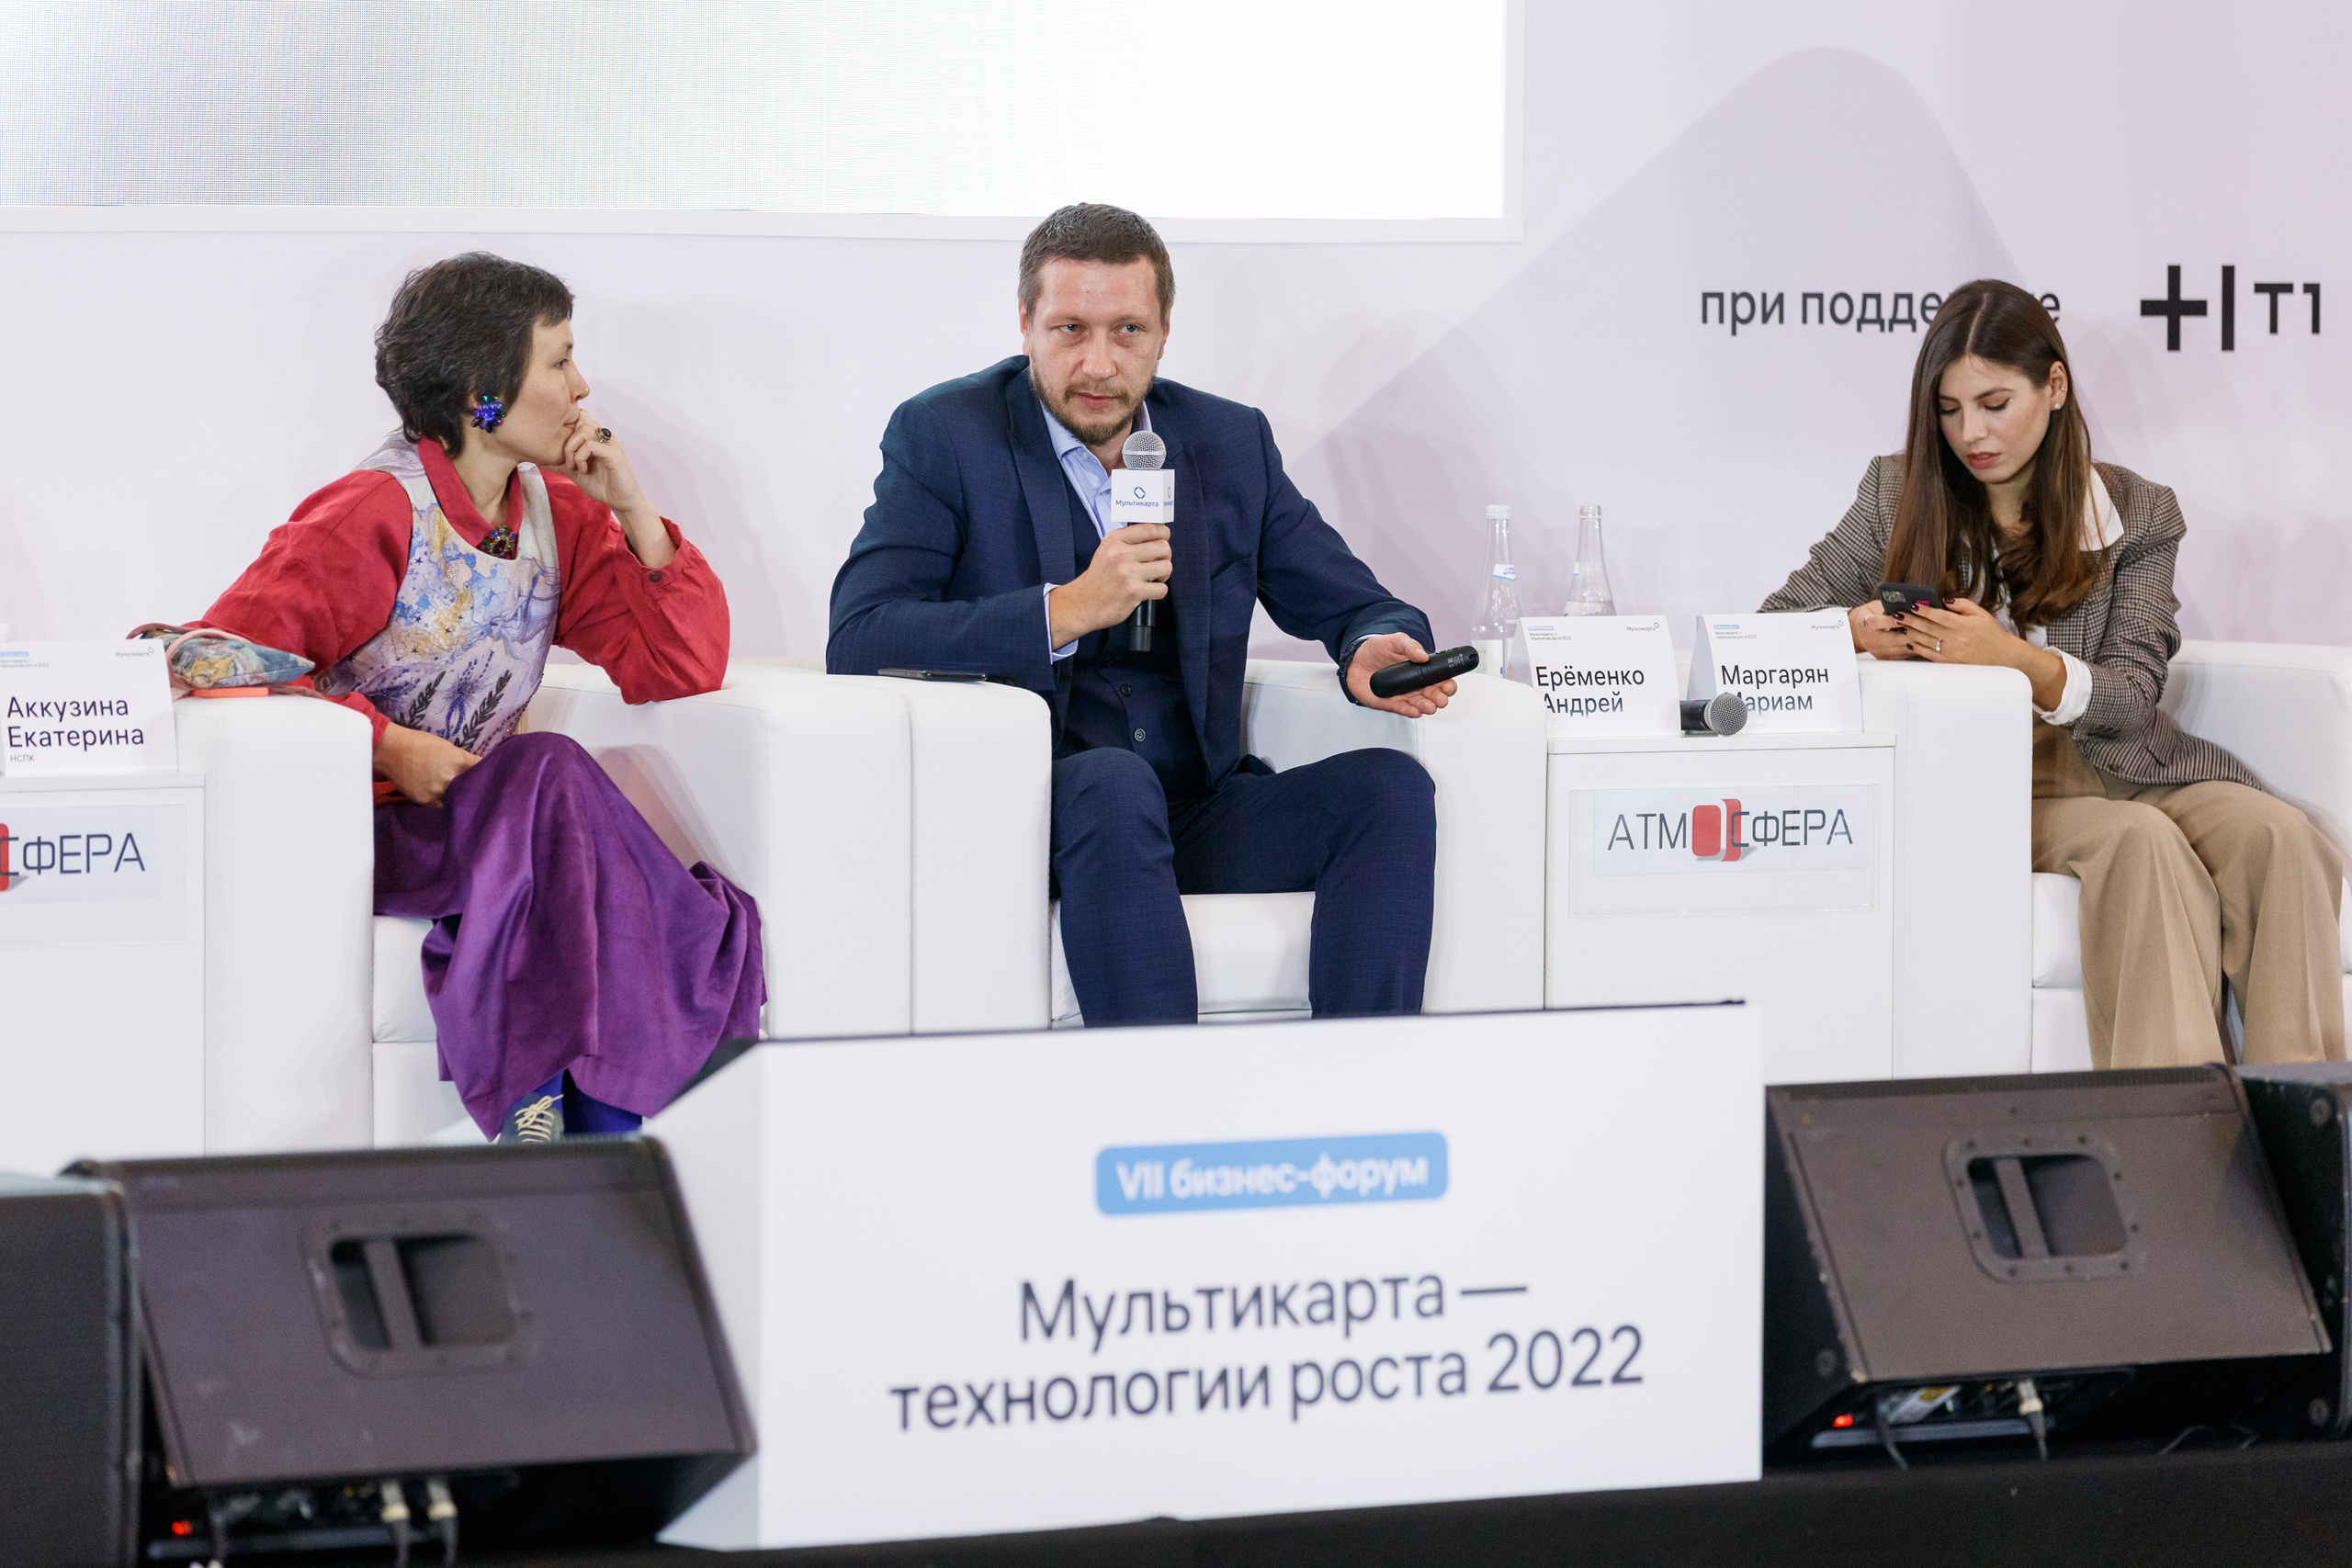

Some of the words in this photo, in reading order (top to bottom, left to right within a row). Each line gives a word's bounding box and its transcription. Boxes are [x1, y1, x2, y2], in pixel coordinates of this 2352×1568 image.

[1701, 291, 1784, 335] при
[1802, 291, 2061, 333] поддее
[1115, 500, 1159, 508] Мультикарта
[1535, 665, 1645, 692] Ерёменко
[1721, 664, 1829, 690] Маргарян
[7, 696, 129, 723] Аккузина
[1544, 691, 1623, 717] Андрей
[1724, 692, 1813, 716] ариам
[7, 726, 144, 751] Екатерина
[10, 754, 35, 762] НСПК
[1115, 1159, 1165, 1201] VII
[1170, 1152, 1430, 1200] бизнес-форум
[1019, 1272, 1445, 1354] Мультикарта
[888, 1365, 1271, 1431] технологии
[1291, 1349, 1467, 1422] роста
[1485, 1325, 1645, 1394] 2022
